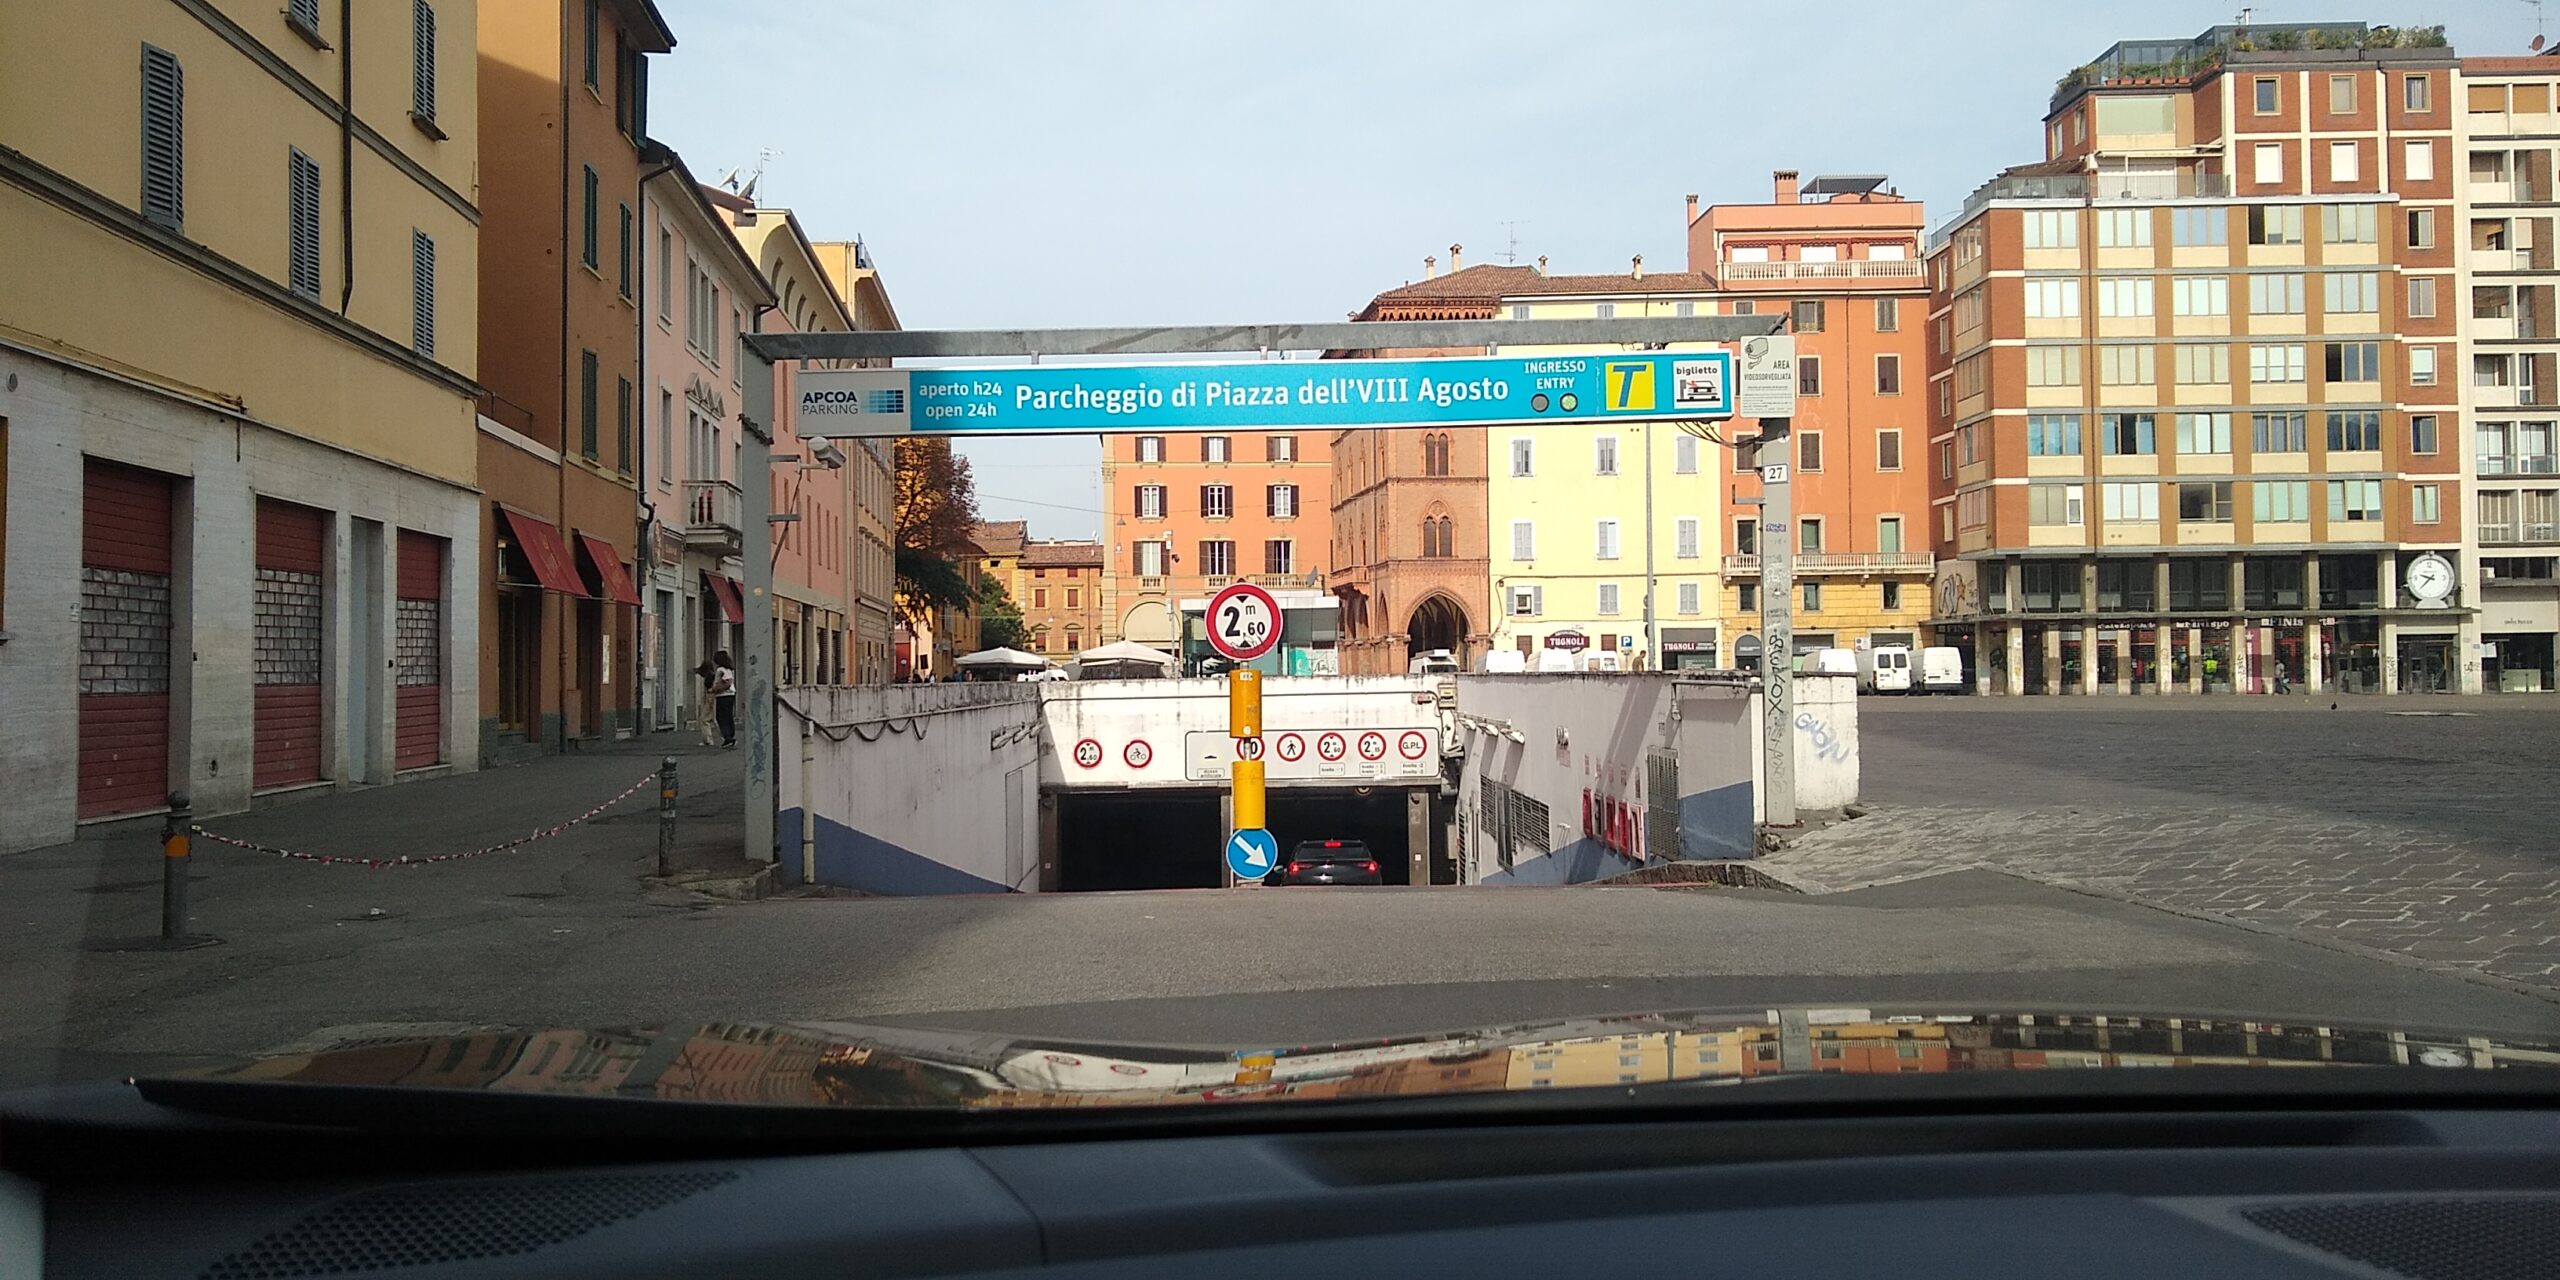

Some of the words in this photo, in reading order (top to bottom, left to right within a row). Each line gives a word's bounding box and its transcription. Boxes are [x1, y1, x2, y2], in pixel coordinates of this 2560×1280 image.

[1524, 360, 1586, 375] INGRESSO
[1675, 363, 1718, 377] biglietto
[1772, 360, 1790, 370] AREA
[1535, 375, 1575, 390] ENTRY
[1612, 364, 1647, 408] T
[802, 389, 857, 404] APCOA
[919, 382, 970, 399] aperto
[973, 381, 1003, 397] h24
[1016, 384, 1163, 415] Parcheggio
[1172, 381, 1195, 407] di
[1206, 380, 1289, 406] Piazza
[1298, 377, 1408, 407] dell'VIII
[1418, 374, 1509, 407] Agosto
[802, 404, 858, 416] PARKING
[925, 404, 964, 419] open
[967, 402, 997, 418] 24h
[1768, 466, 1783, 480] 27
[1549, 637, 1585, 646] TUGNOLI
[1622, 637, 1630, 646] P
[1663, 642, 1695, 651] TUGNOLI
